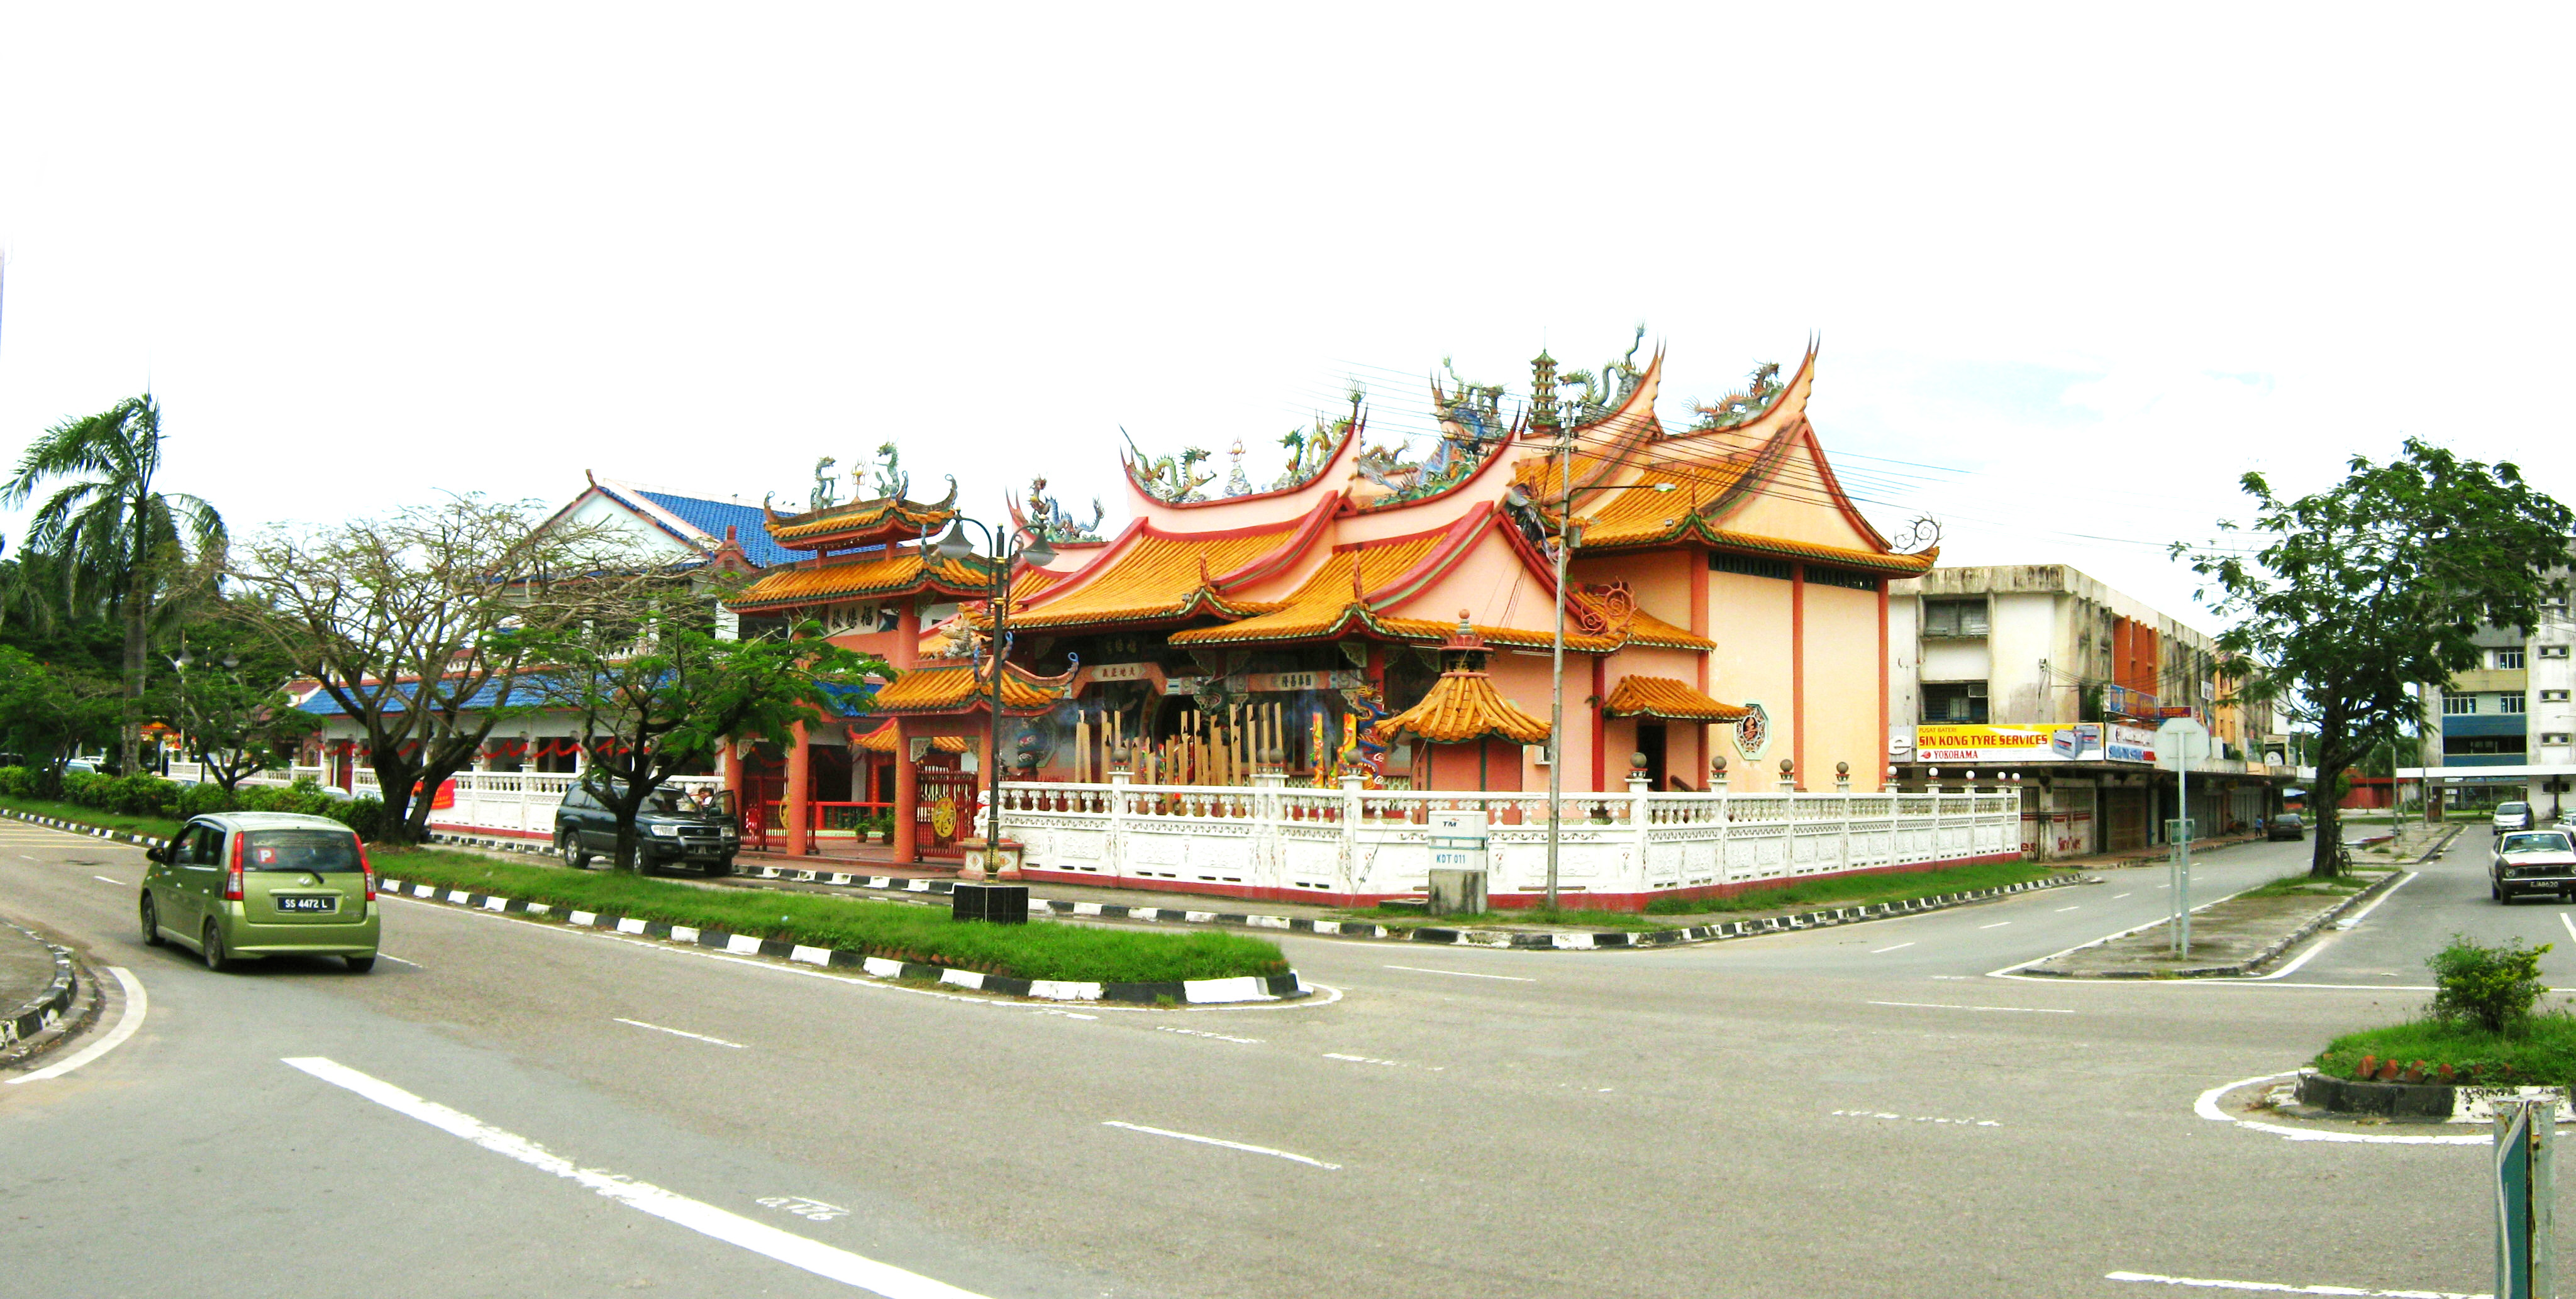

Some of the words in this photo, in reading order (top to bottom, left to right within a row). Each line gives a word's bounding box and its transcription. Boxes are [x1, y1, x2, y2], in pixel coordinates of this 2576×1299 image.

[1919, 736, 1936, 746] SIN
[1939, 736, 1968, 746] KONG
[1970, 735, 1997, 746] TYRE
[1999, 734, 2048, 745] SERVICES
[1933, 750, 1979, 760] YOKOHAMA
[260, 850, 272, 862] P
[1436, 854, 1452, 864] KDT
[1454, 854, 1465, 864] 011
[285, 898, 296, 909] SS
[298, 898, 319, 909] 4472
[321, 898, 328, 909] L
